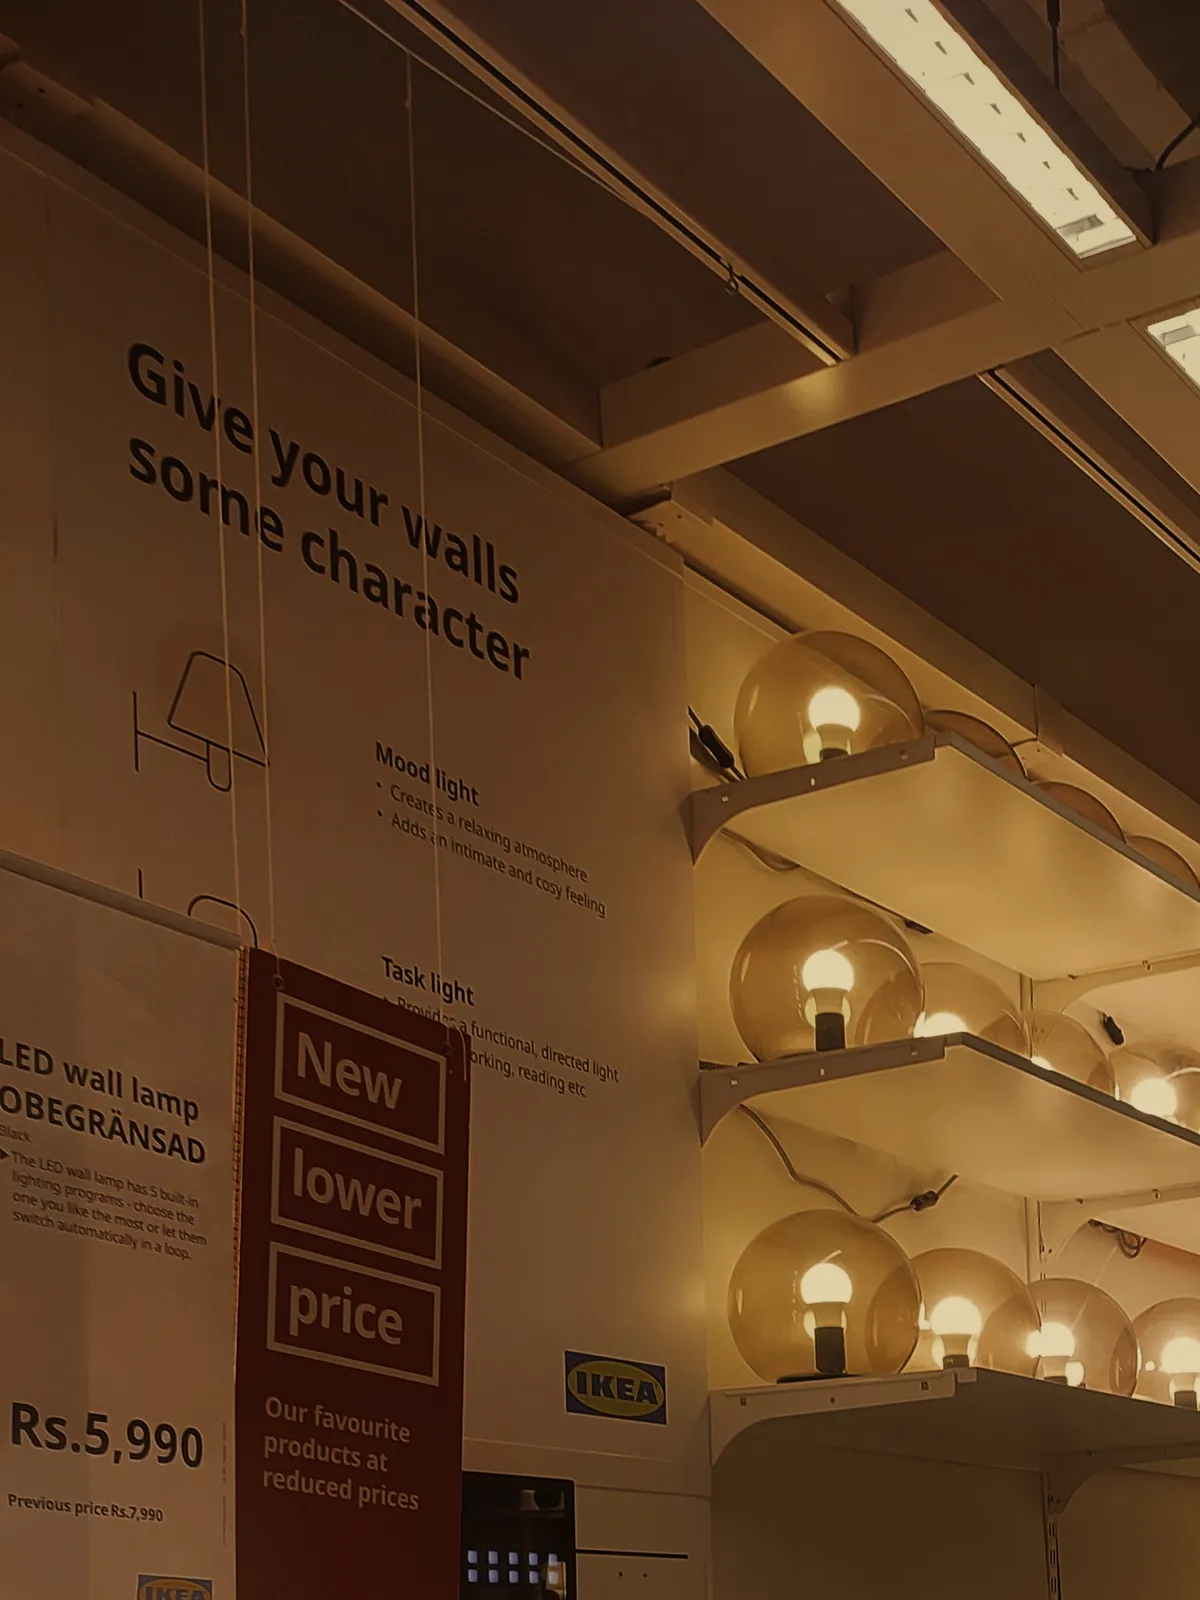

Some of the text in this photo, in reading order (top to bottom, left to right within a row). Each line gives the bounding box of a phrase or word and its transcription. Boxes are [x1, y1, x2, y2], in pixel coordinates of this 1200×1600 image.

[128, 343, 519, 603] Give your walls
[129, 437, 530, 680] some character
[376, 741, 479, 807] Mood light
[391, 785, 588, 883] Creates a relaxing atmosphere
[391, 814, 606, 919] Adds an intimate and cosy feeling
[381, 954, 475, 1007] Task light
[0, 1037, 199, 1126] LED wall lamp
[297, 1030, 404, 1110] New
[470, 1048, 587, 1098] orking, reading etc
[471, 1019, 538, 1058] functional,
[541, 1043, 590, 1073] directed
[593, 1052, 619, 1084] light
[0, 1086, 206, 1164] OBEGRÄNSAD
[292, 1147, 422, 1230] lower
[288, 1281, 404, 1346] price
[265, 1396, 411, 1444] Our favourite
[576, 1371, 658, 1406] IKEA
[11, 1401, 203, 1469] Rs.5,990
[263, 1433, 388, 1472] products at
[8, 1493, 164, 1522] Previous price Rs.7,990
[262, 1468, 420, 1511] reduced prices
